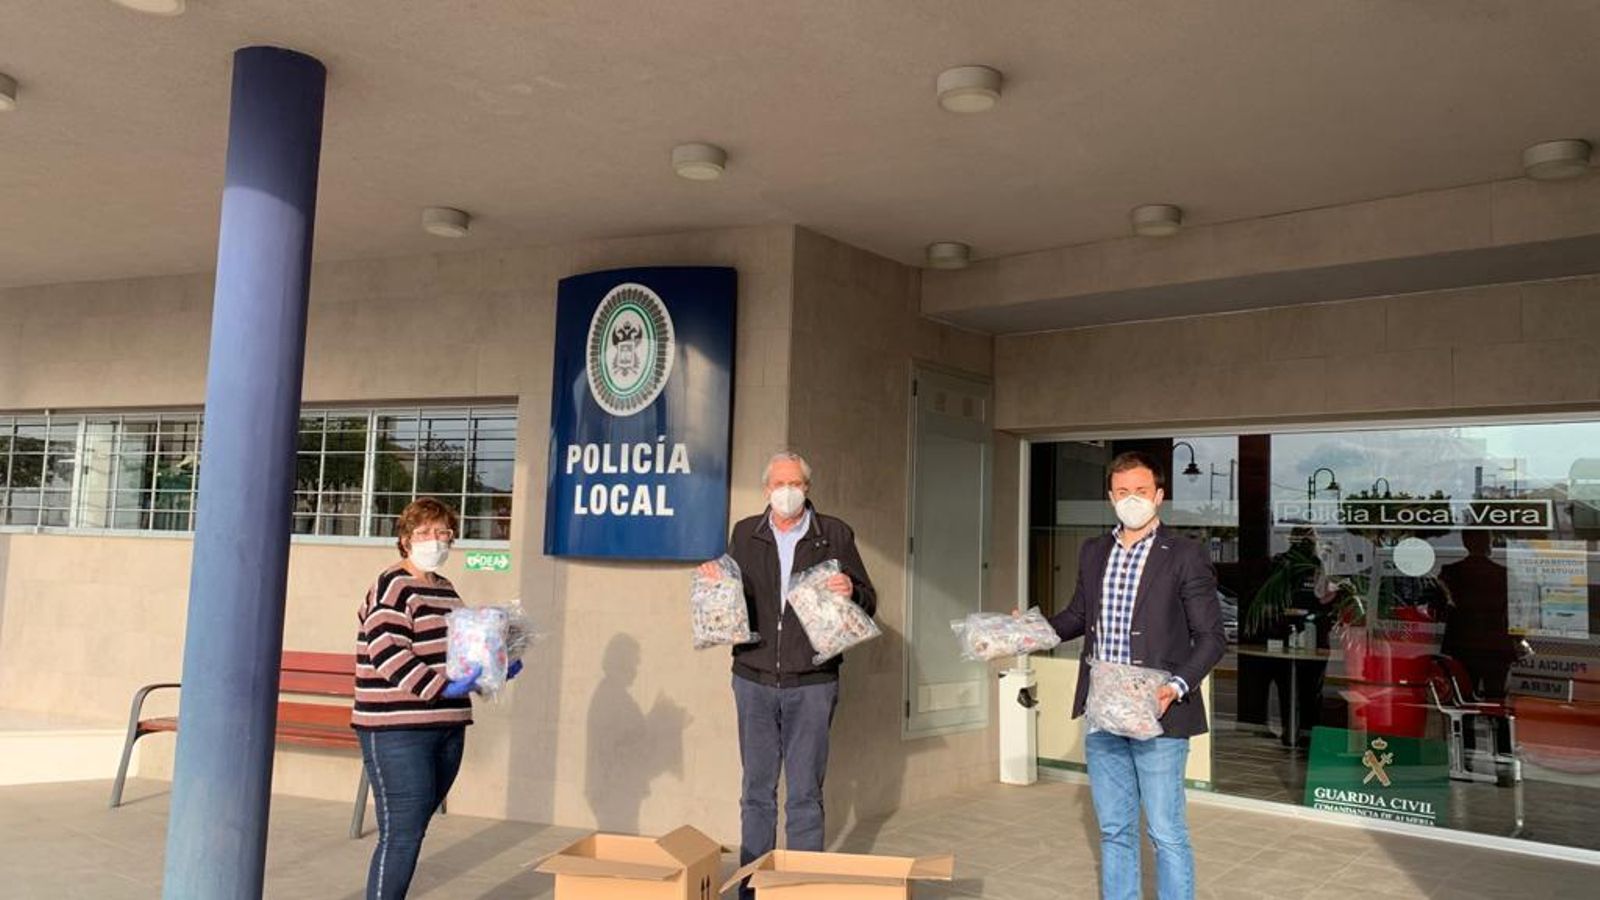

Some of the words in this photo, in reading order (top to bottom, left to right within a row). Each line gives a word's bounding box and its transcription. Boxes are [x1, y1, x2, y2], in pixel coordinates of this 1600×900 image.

[566, 436, 691, 475] POLICÍA
[574, 484, 674, 516] LOCAL
[1380, 504, 1458, 524] Local
[1465, 504, 1541, 524] Vera
[1314, 786, 1387, 807] GUARDIA
[1390, 797, 1436, 815] CIVIL
